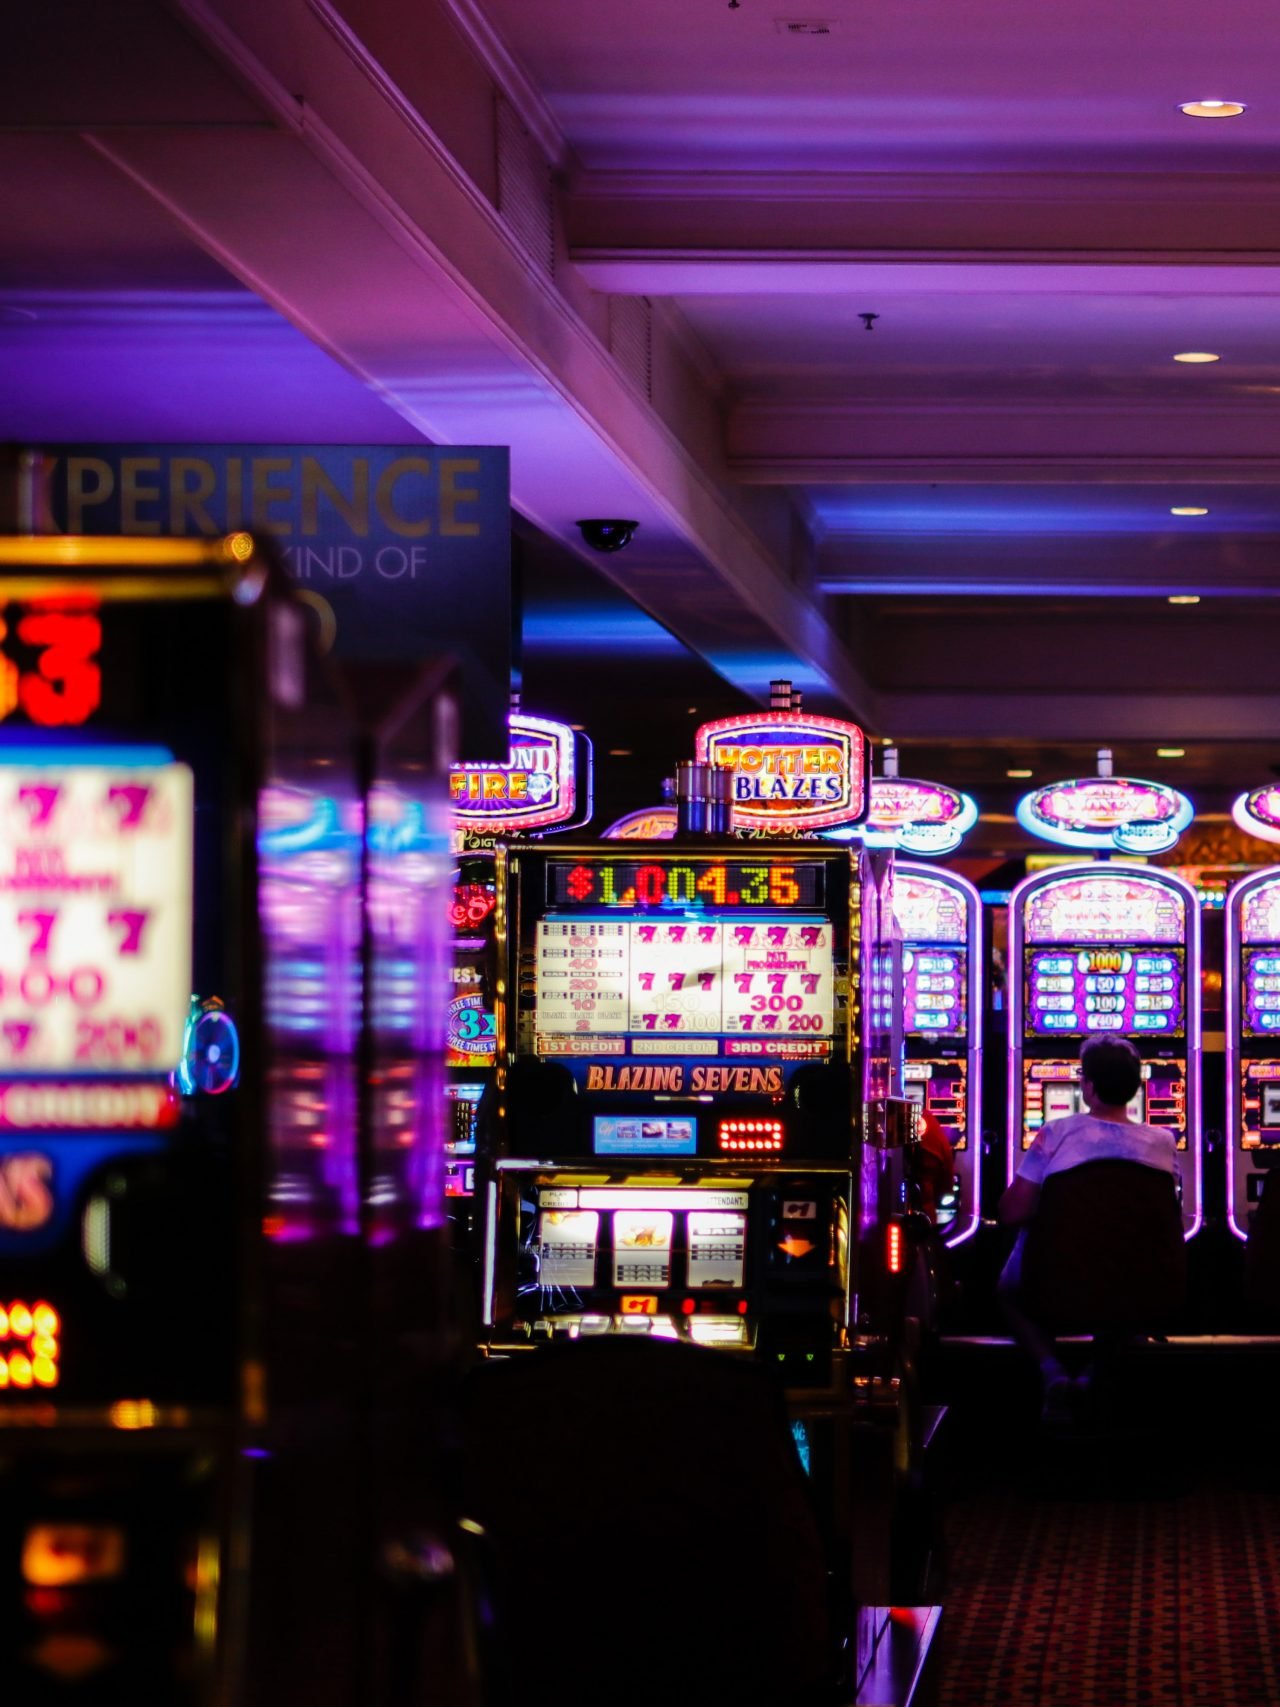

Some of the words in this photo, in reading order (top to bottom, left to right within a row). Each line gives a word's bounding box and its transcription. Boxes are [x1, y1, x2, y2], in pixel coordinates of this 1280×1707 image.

[375, 545, 427, 579] OF
[717, 745, 844, 774] HOTTER
[449, 772, 528, 800] FIRE
[735, 775, 842, 801] BLAZES
[566, 865, 799, 905] $1,004.35
[1087, 952, 1123, 972] 1000
[0, 965, 105, 1008] 00
[1096, 978, 1114, 989] 50
[571, 998, 596, 1011] 10
[750, 994, 804, 1012] 300
[1094, 996, 1118, 1009] 100
[788, 1014, 824, 1031] 200
[1096, 1015, 1113, 1027] 40
[543, 1042, 570, 1052] 1ST
[571, 1042, 622, 1052] CREDIT
[665, 1042, 714, 1052] CREDIT
[731, 1041, 763, 1053] 3RD
[765, 1042, 823, 1053] CREDIT
[585, 1065, 684, 1092] BLAZING
[690, 1065, 785, 1093] SEVENS
